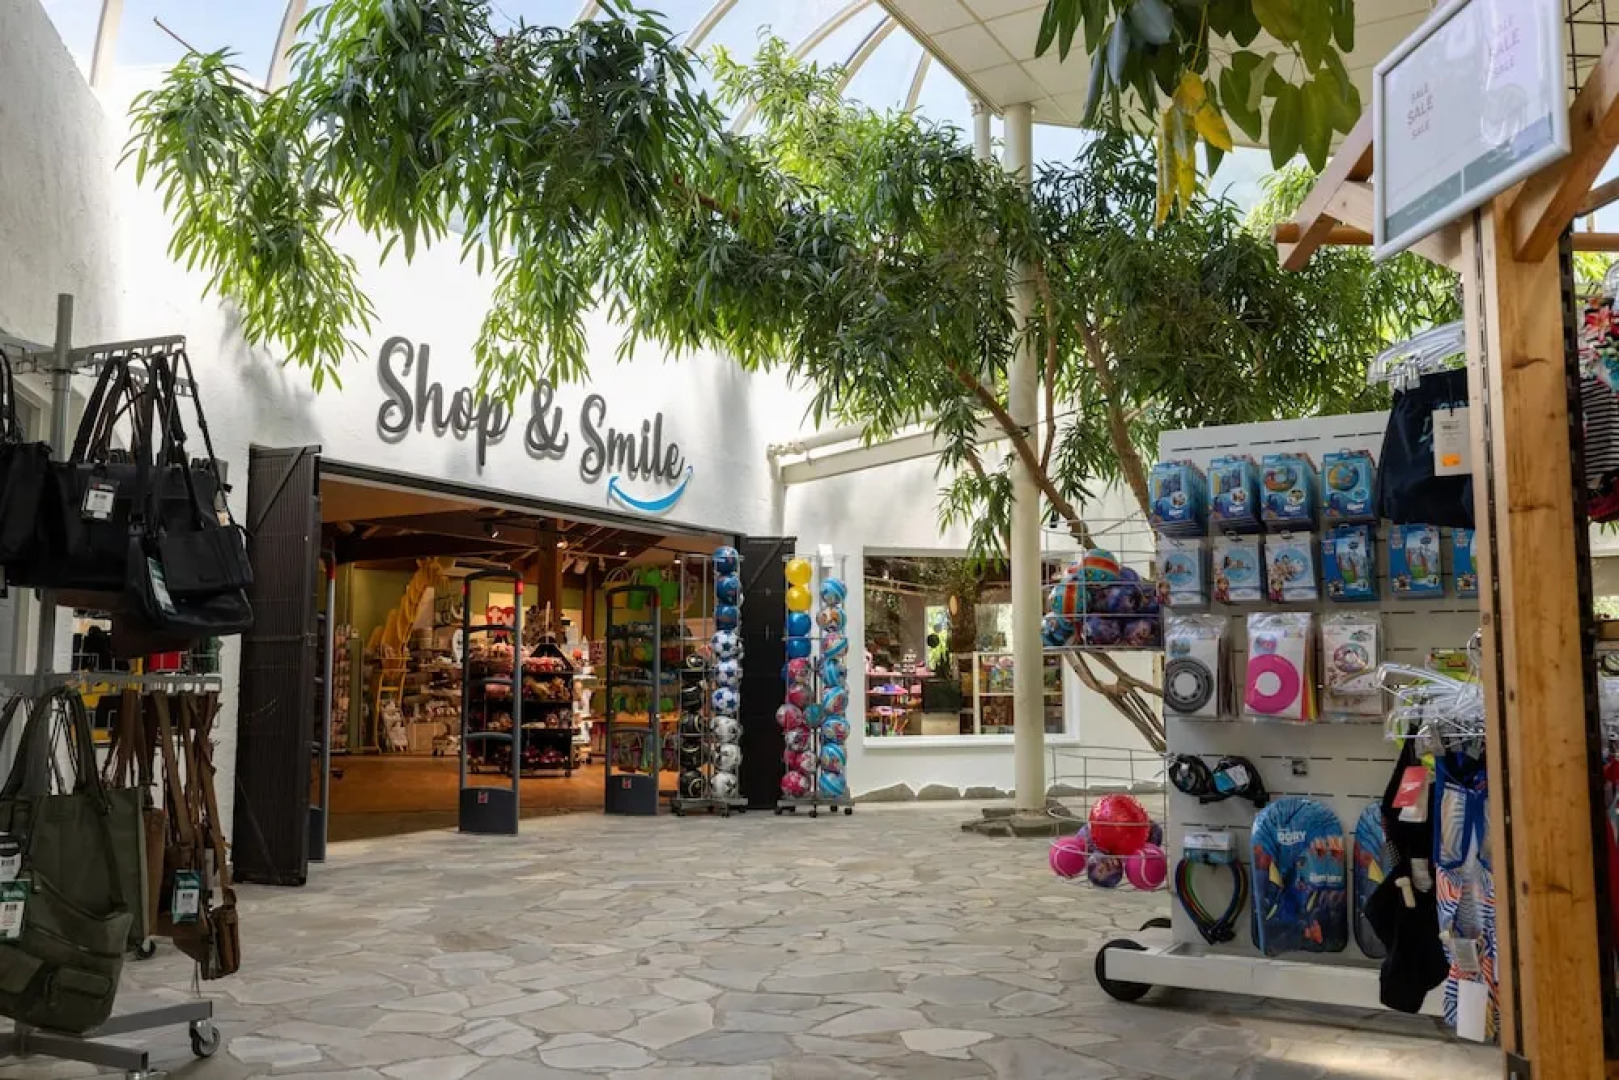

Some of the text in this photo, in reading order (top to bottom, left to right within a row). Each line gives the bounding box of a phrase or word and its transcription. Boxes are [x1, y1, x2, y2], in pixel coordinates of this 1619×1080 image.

[1407, 95, 1434, 126] SALE
[378, 336, 686, 481] Shop & Smile
